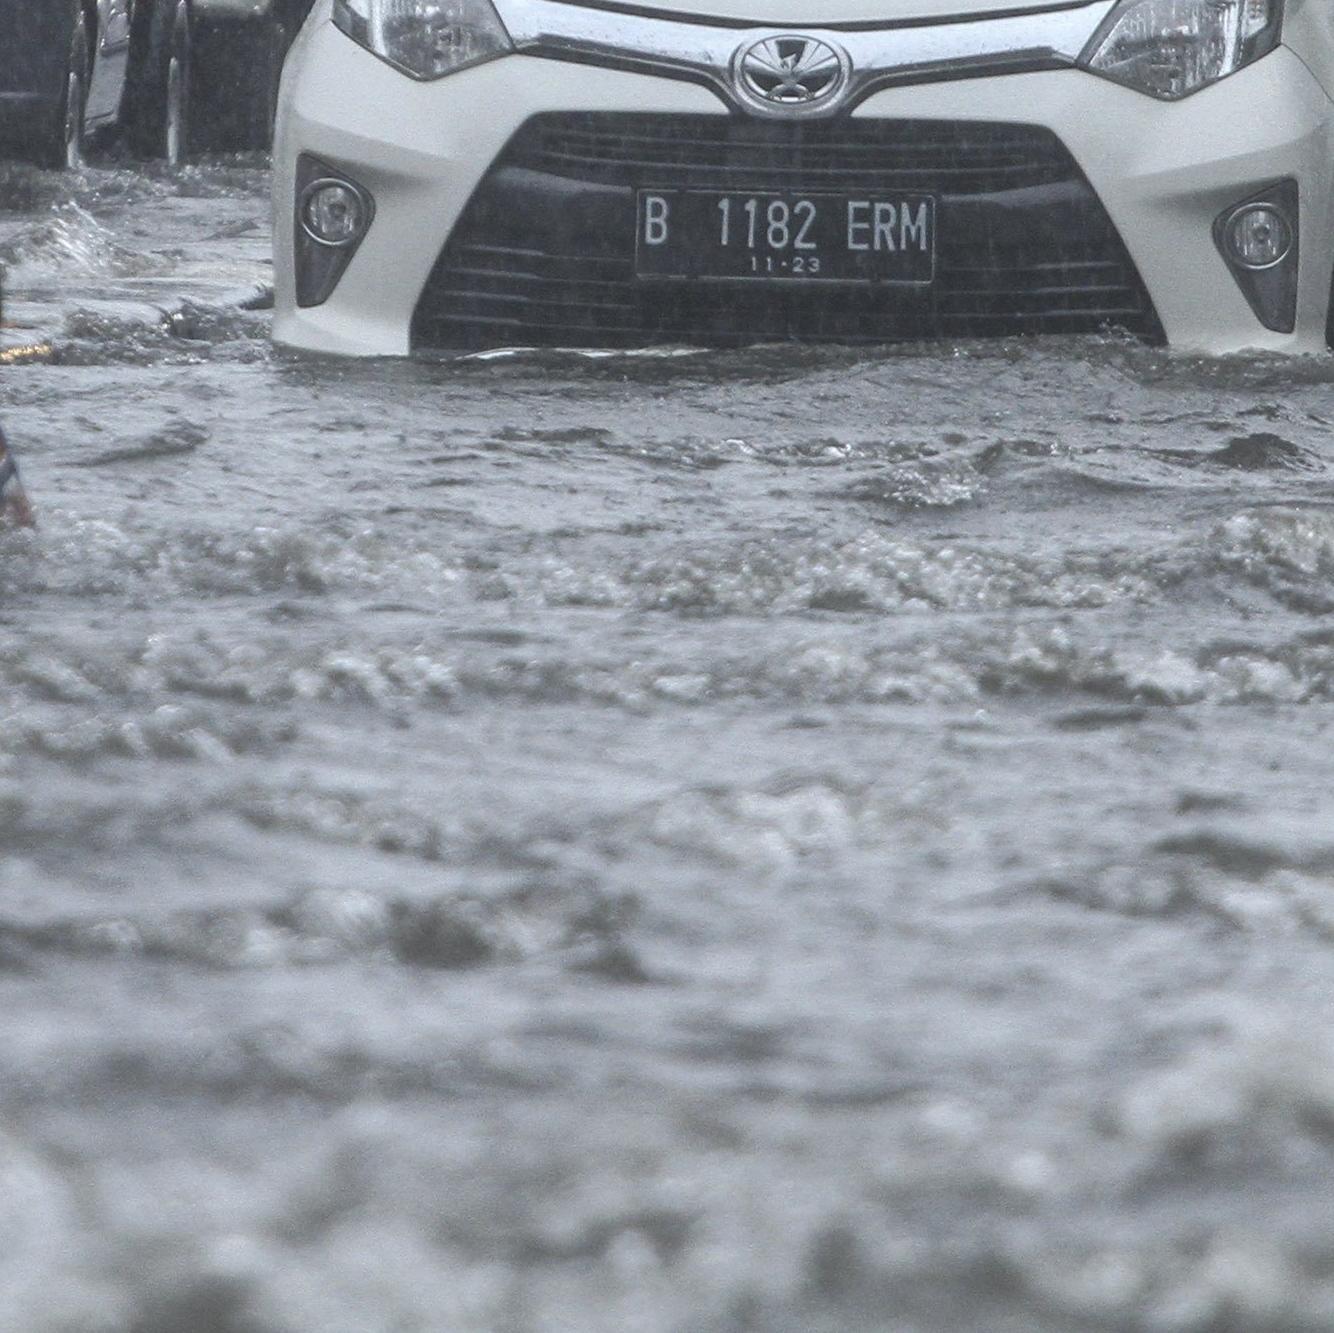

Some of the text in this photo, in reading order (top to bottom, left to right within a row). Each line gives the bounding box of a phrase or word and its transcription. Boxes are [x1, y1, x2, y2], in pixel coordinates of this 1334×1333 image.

[645, 197, 929, 251] B 1182 ERM
